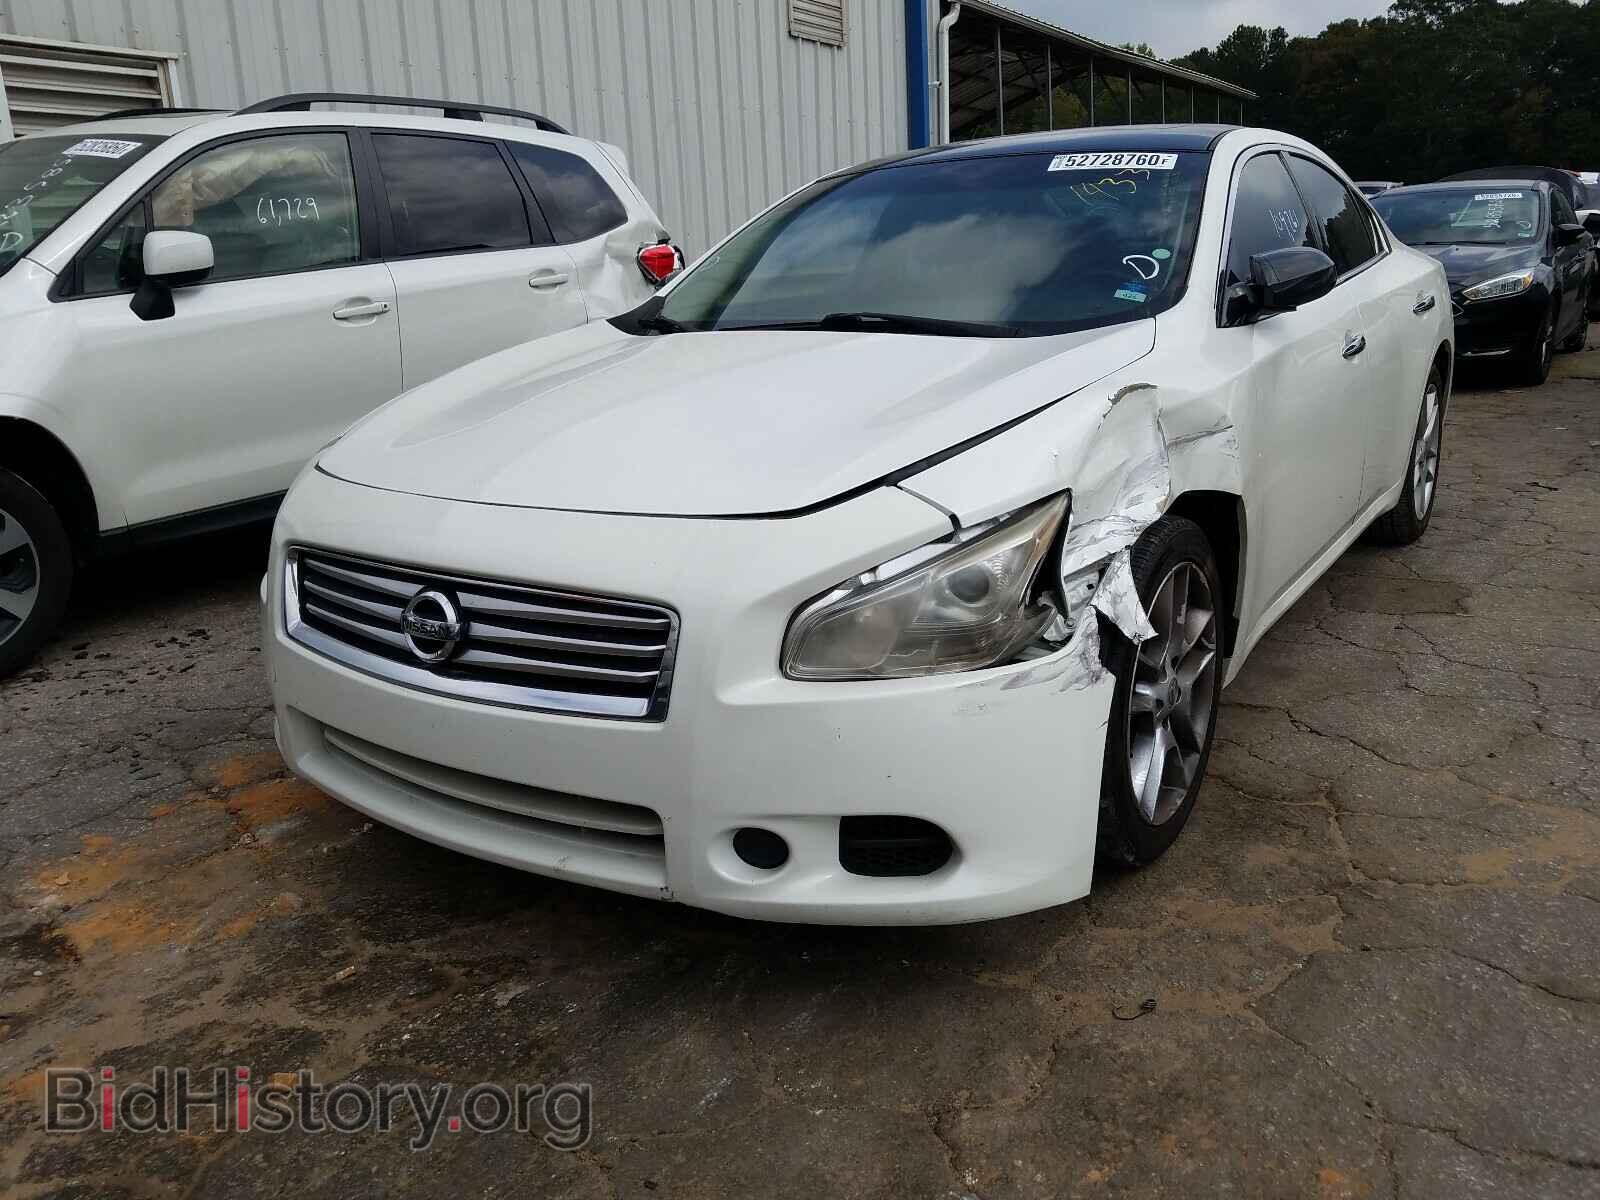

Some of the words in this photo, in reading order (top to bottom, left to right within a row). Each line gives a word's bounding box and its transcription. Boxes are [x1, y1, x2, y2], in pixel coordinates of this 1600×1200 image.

[1065, 153, 1160, 167] 52728760
[257, 197, 320, 227] 61,729
[1122, 254, 1160, 280] D
[403, 618, 449, 639] NISSAN
